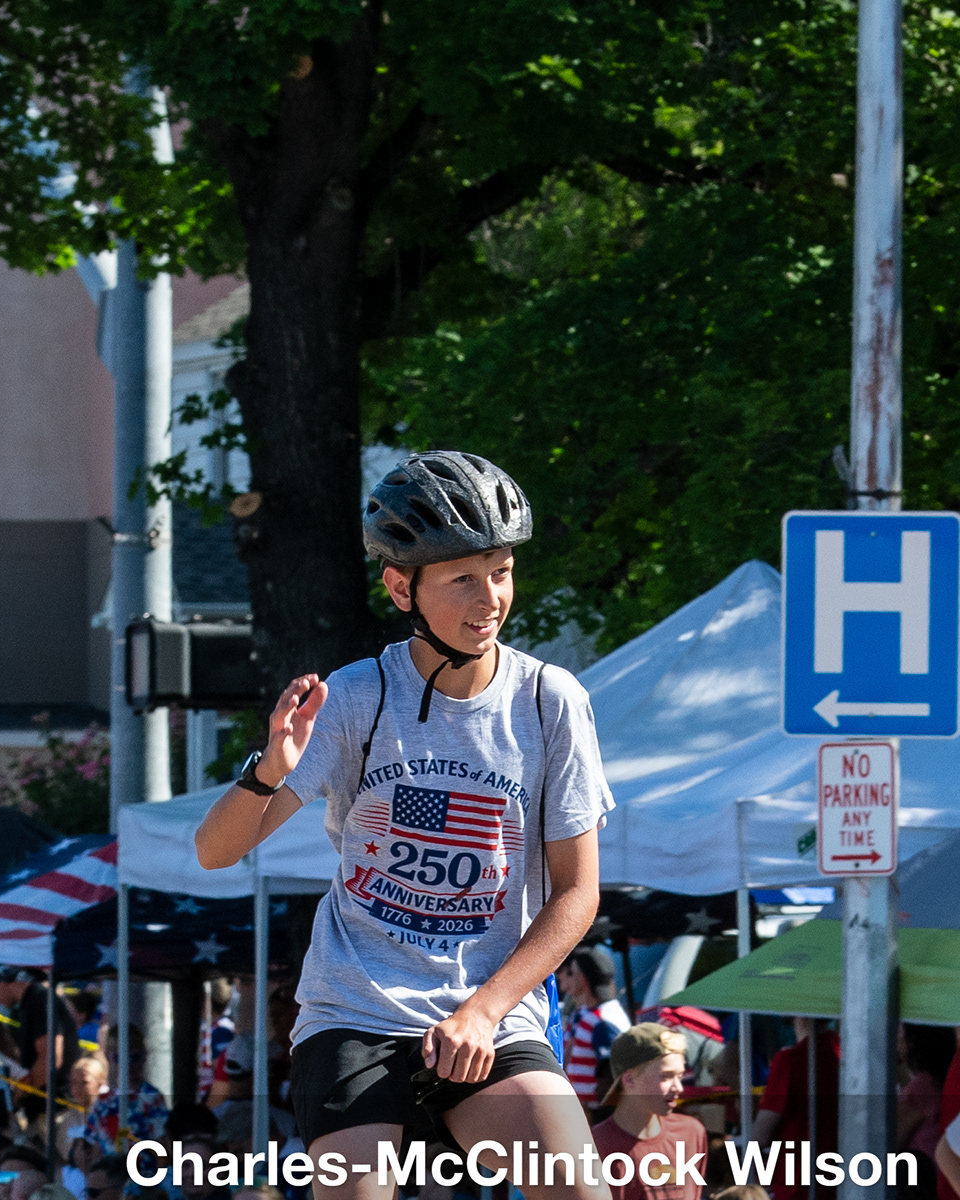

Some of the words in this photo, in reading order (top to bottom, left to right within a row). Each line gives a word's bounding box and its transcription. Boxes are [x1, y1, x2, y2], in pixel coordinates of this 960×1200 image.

[814, 530, 931, 674] H
[358, 762, 404, 795] NITED
[409, 759, 469, 778] STATES
[469, 770, 483, 782] of
[843, 754, 871, 778] NO
[823, 783, 890, 807] PARKING
[842, 811, 871, 827] ANY
[840, 830, 875, 847] TIME
[369, 877, 494, 913] ANNIVERSARY
[381, 906, 412, 926] 1776
[436, 919, 474, 932] 2026
[398, 931, 438, 949] JULY
[439, 939, 449, 952] 4
